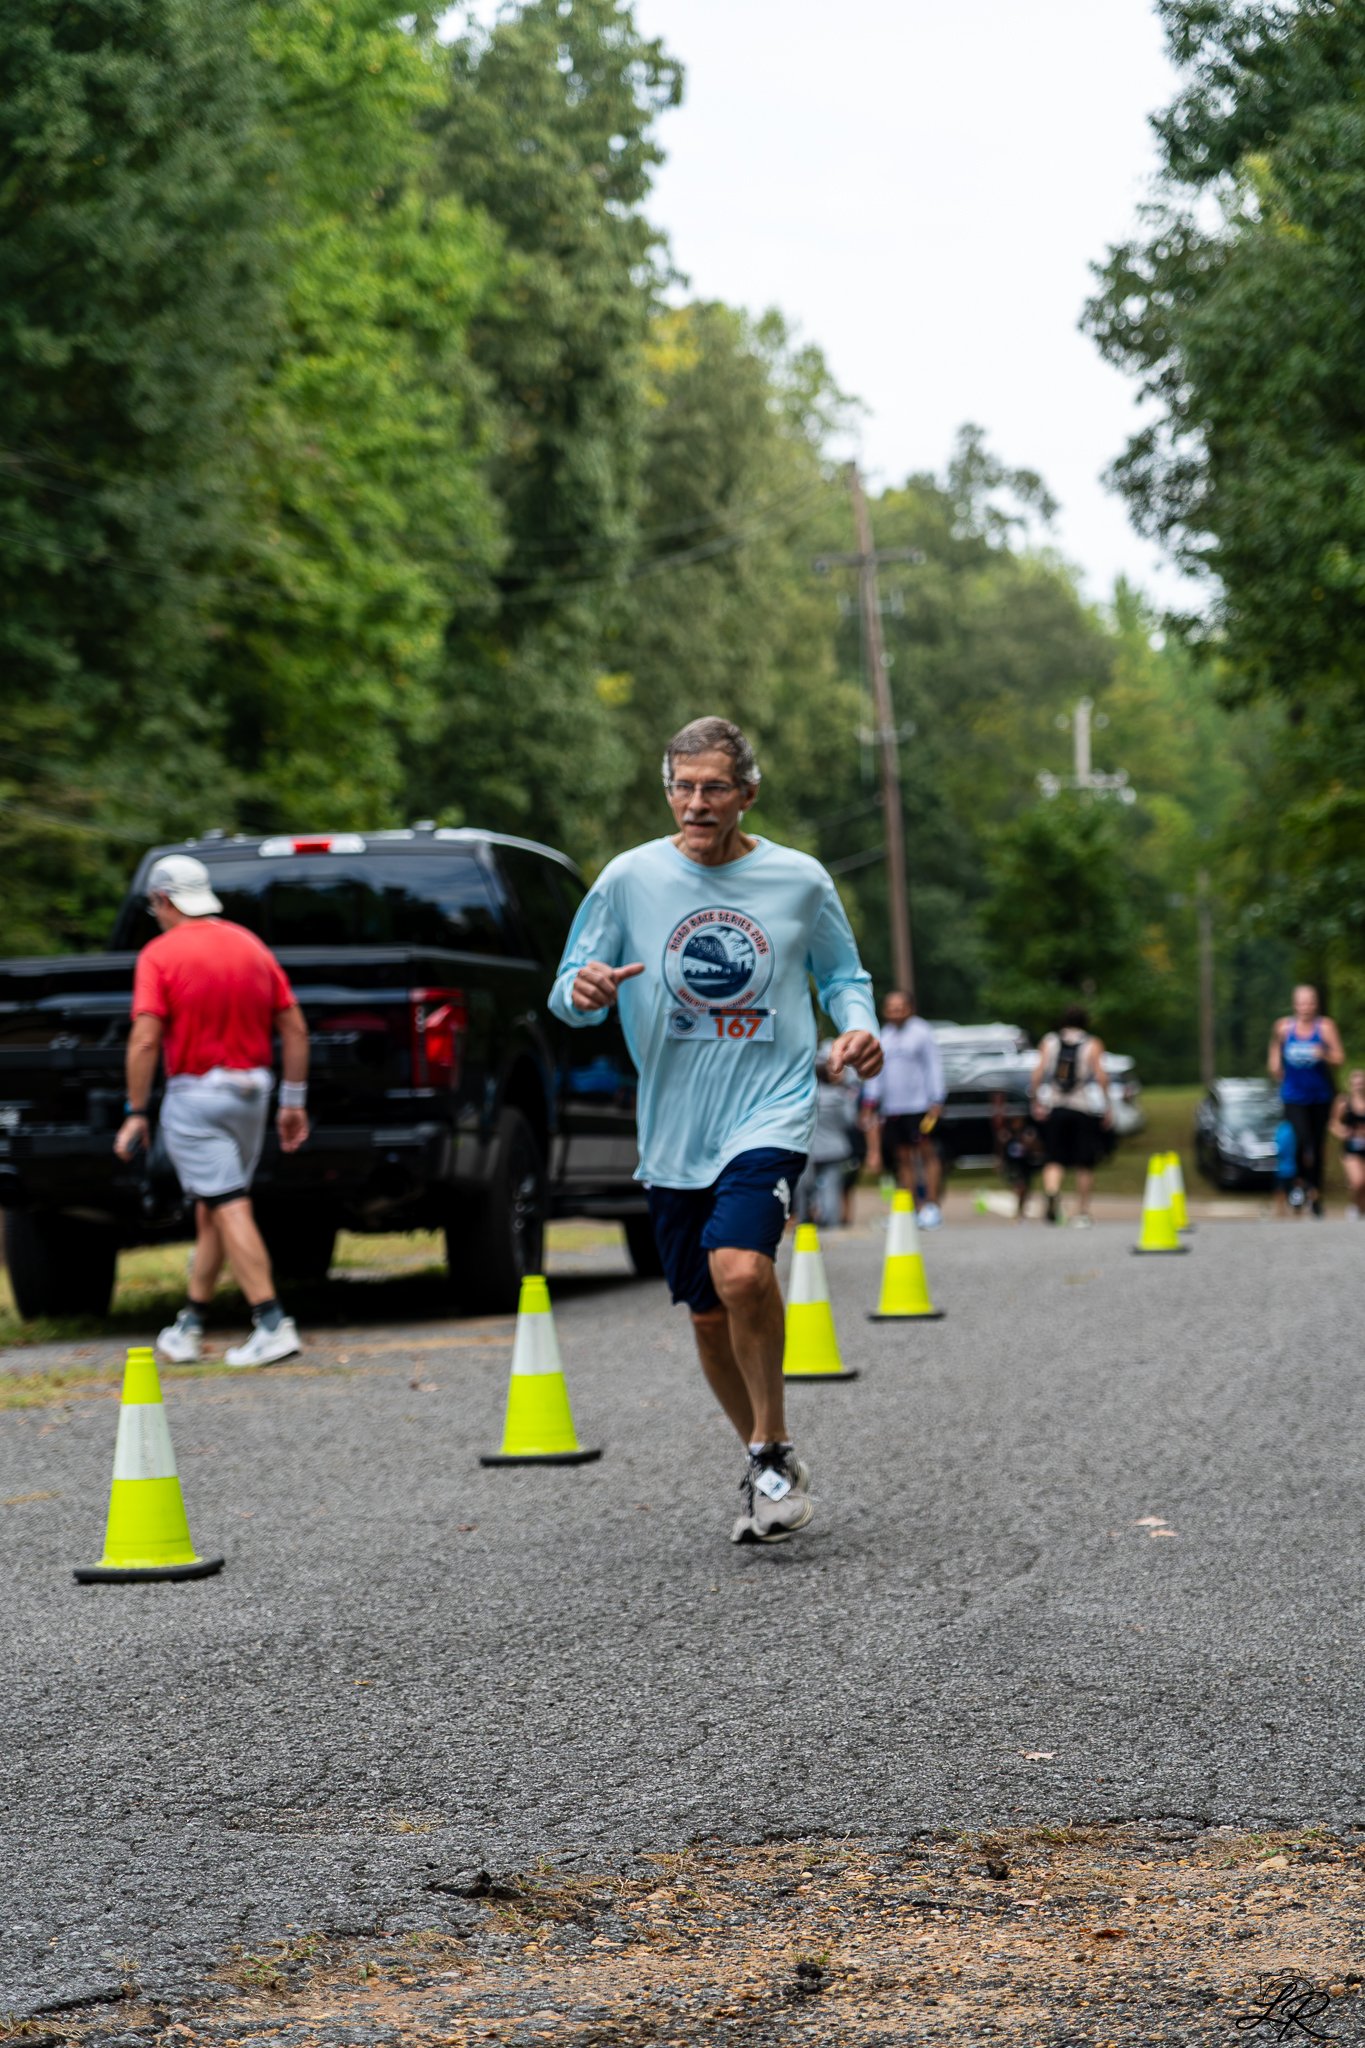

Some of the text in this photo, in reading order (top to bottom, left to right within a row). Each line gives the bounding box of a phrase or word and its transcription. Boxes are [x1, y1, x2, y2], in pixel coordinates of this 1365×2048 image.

[669, 925, 690, 952] ROAD
[689, 911, 715, 928] RACE
[717, 911, 753, 931] SERIES
[714, 1017, 763, 1038] 167
